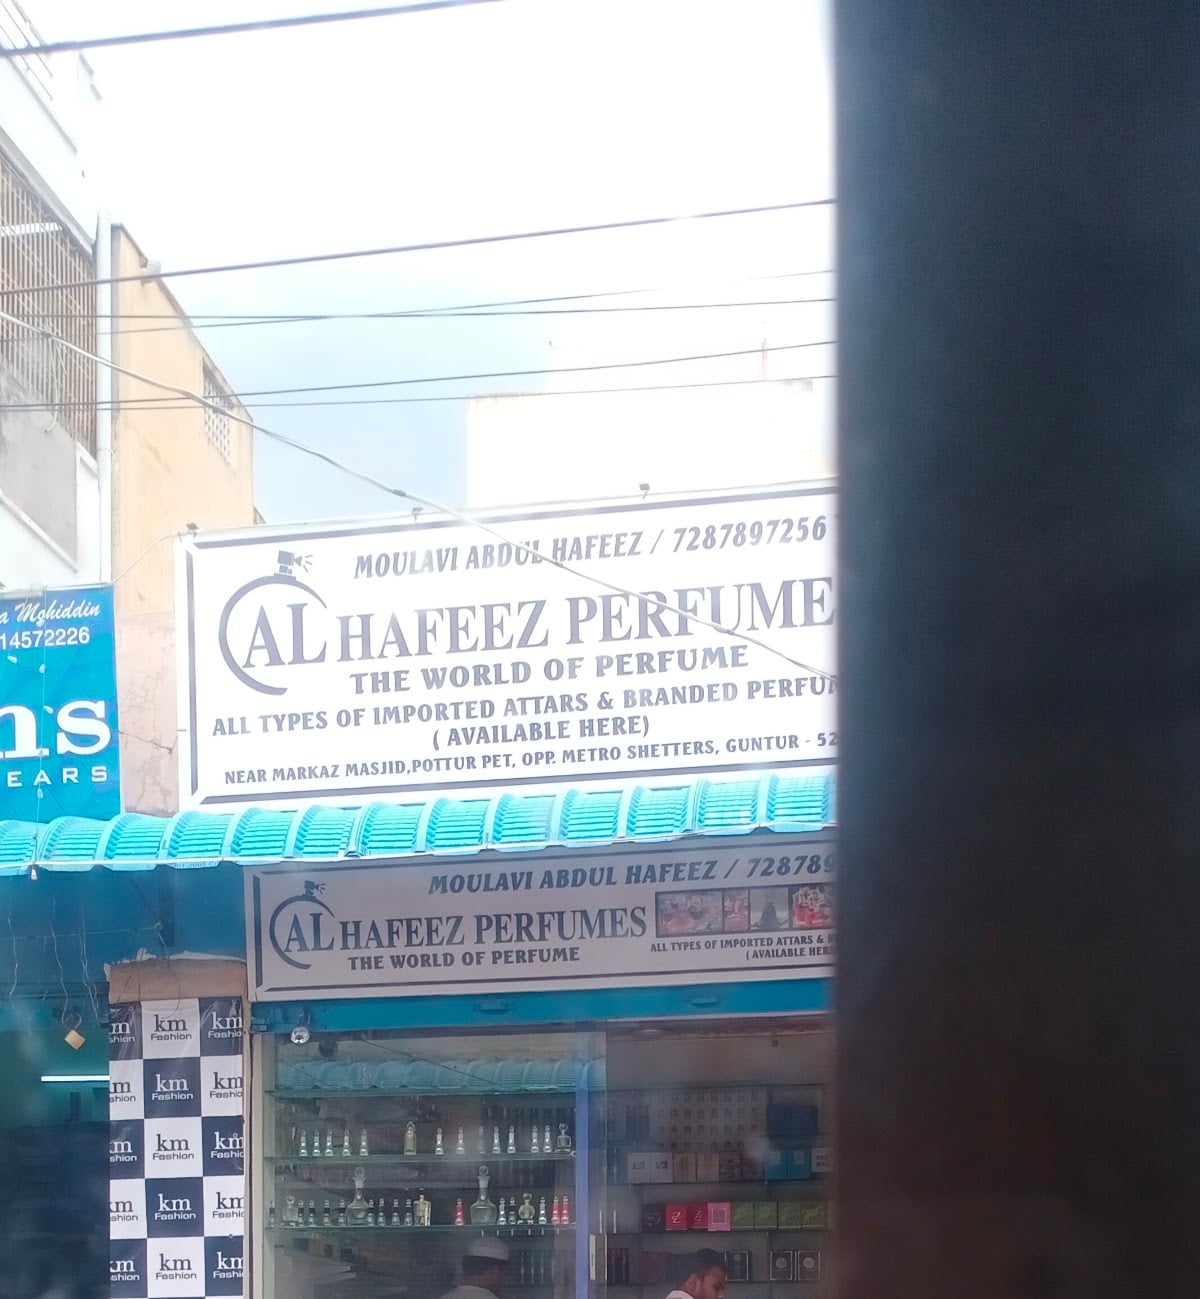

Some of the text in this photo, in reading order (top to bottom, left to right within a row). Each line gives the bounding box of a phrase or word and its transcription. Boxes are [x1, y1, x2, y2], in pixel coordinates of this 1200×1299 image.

[354, 547, 459, 579] MOULAVI
[465, 539, 544, 569] ABDUL
[551, 531, 644, 563] HAFEEZ
[673, 515, 827, 552] 7287897256
[241, 602, 327, 668] AL
[336, 601, 549, 662] HAFEEZ
[349, 645, 749, 694] THE WORLD OF PERFUME
[212, 716, 251, 736] ALL
[258, 711, 328, 733] TYPES
[337, 708, 366, 727] OF
[373, 699, 495, 725] IMPORTED
[503, 693, 588, 717] ATTARS
[597, 691, 614, 710] &
[623, 682, 738, 709] BRANDED
[447, 720, 570, 746] AVAILABLE
[579, 715, 649, 738] HERE)
[225, 769, 267, 784] NEAR
[272, 765, 340, 782] MARKAZ
[482, 753, 516, 769] PET,
[522, 751, 556, 766] OPP.
[562, 746, 621, 763] METRO
[627, 741, 719, 759] SHETTERS,
[726, 734, 799, 753] GUNTUR
[428, 872, 533, 894] MOULAVI
[539, 866, 617, 888] ABDUL
[625, 860, 718, 884] HAFEEZ
[284, 906, 647, 953] AL HAFEEZ PERFUMES
[650, 943, 668, 952] ALL
[671, 941, 701, 951] TYPES
[705, 940, 718, 949] OF
[720, 937, 773, 949] IMPORTED
[776, 934, 813, 946] ATTARS
[816, 934, 824, 944] &
[348, 946, 580, 971] THE WORLD OF PERFUME
[752, 947, 805, 959] AVAILABLE
[154, 1014, 187, 1032] km
[211, 1011, 243, 1029] km
[150, 1033, 192, 1041] Fashion
[155, 1074, 189, 1092] km
[213, 1072, 243, 1089] km
[152, 1092, 194, 1101] Fashion
[156, 1134, 190, 1151] km
[152, 1152, 194, 1160] Fashion
[158, 1193, 192, 1211] km
[154, 1212, 196, 1220] Fashion
[159, 1253, 192, 1271] km
[156, 1272, 197, 1280] Fashion
